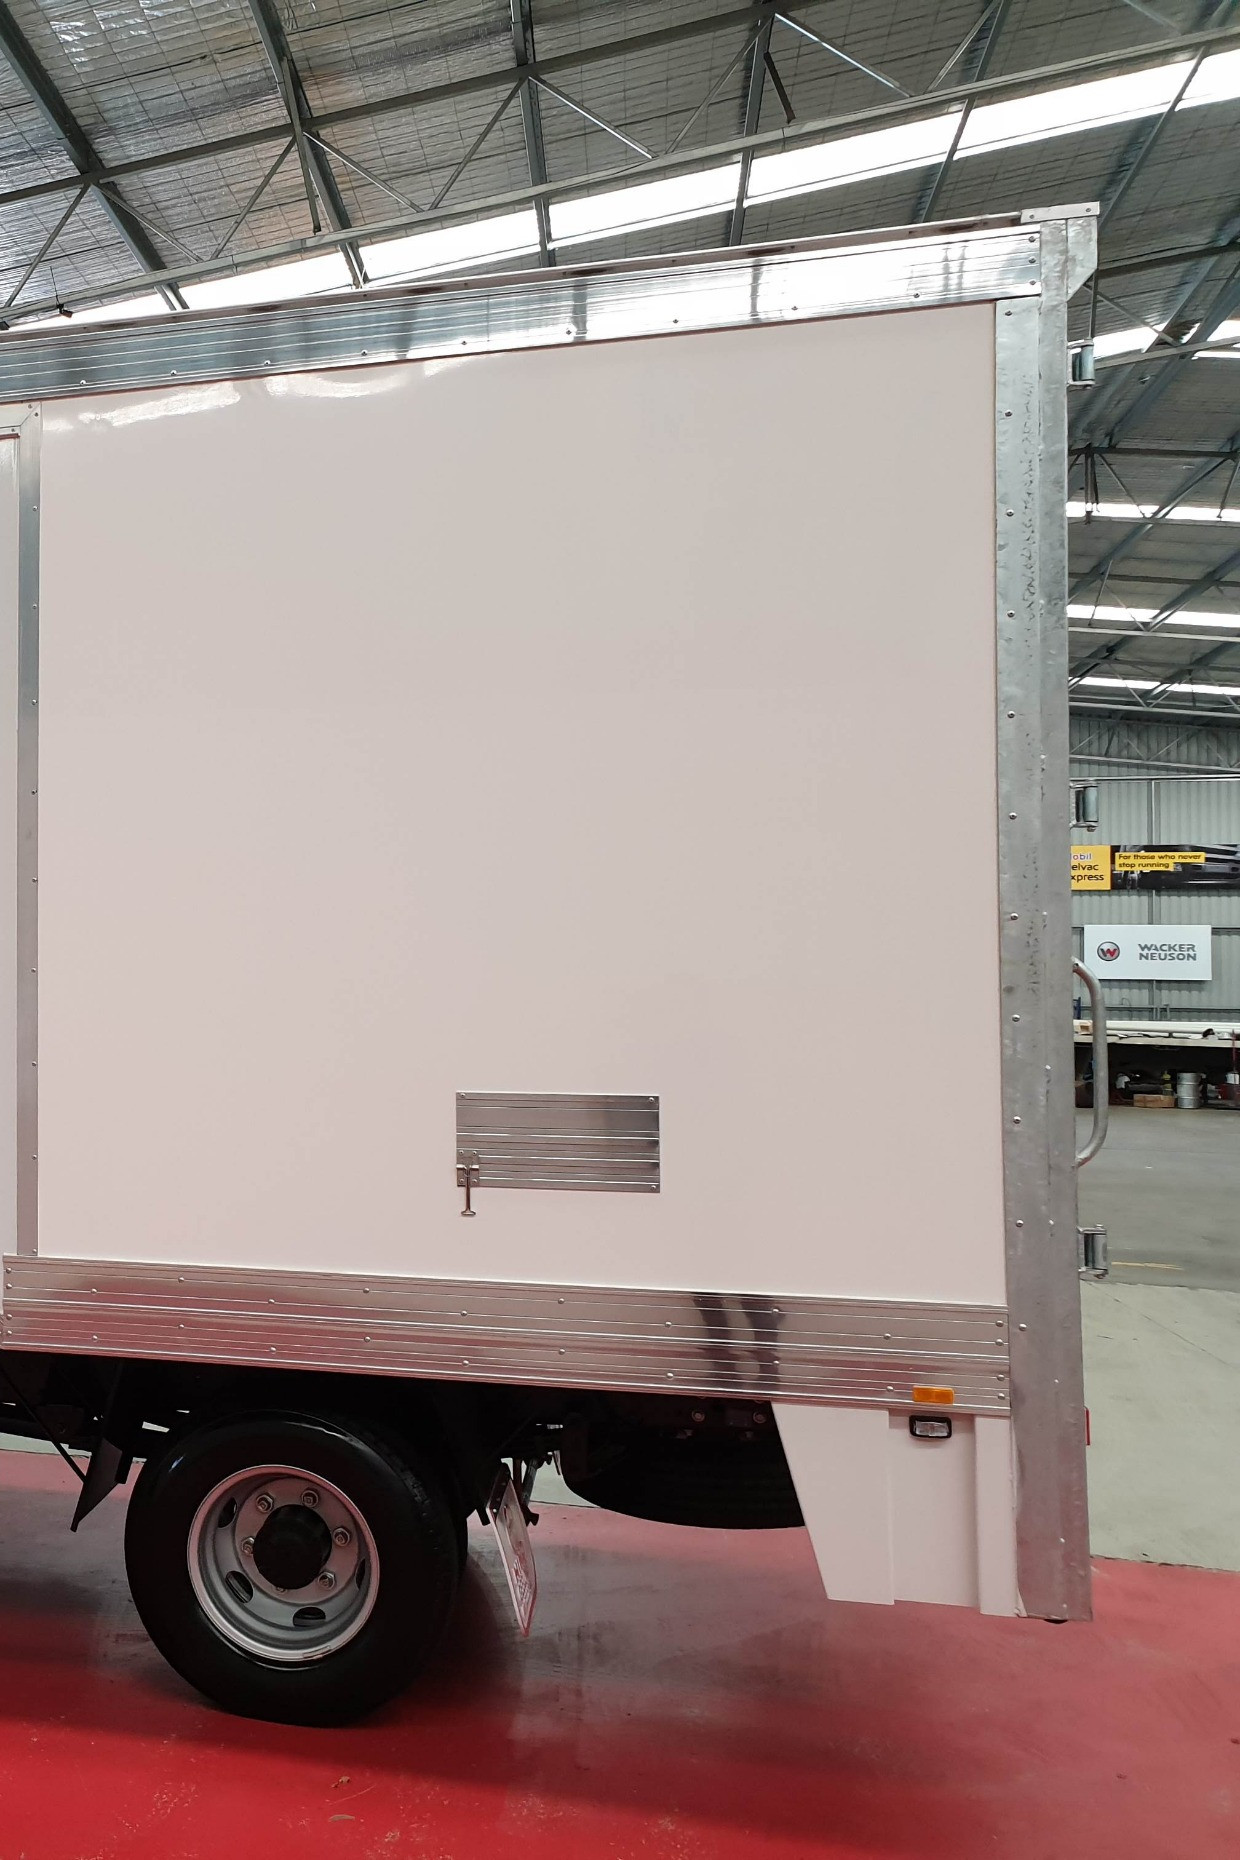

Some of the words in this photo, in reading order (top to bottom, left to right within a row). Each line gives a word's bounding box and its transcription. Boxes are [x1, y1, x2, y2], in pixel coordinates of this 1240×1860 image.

[1071, 863, 1099, 871] elvac
[1071, 874, 1105, 883] xpress
[1138, 943, 1196, 952] WACKER
[1139, 952, 1197, 961] NEUSON
